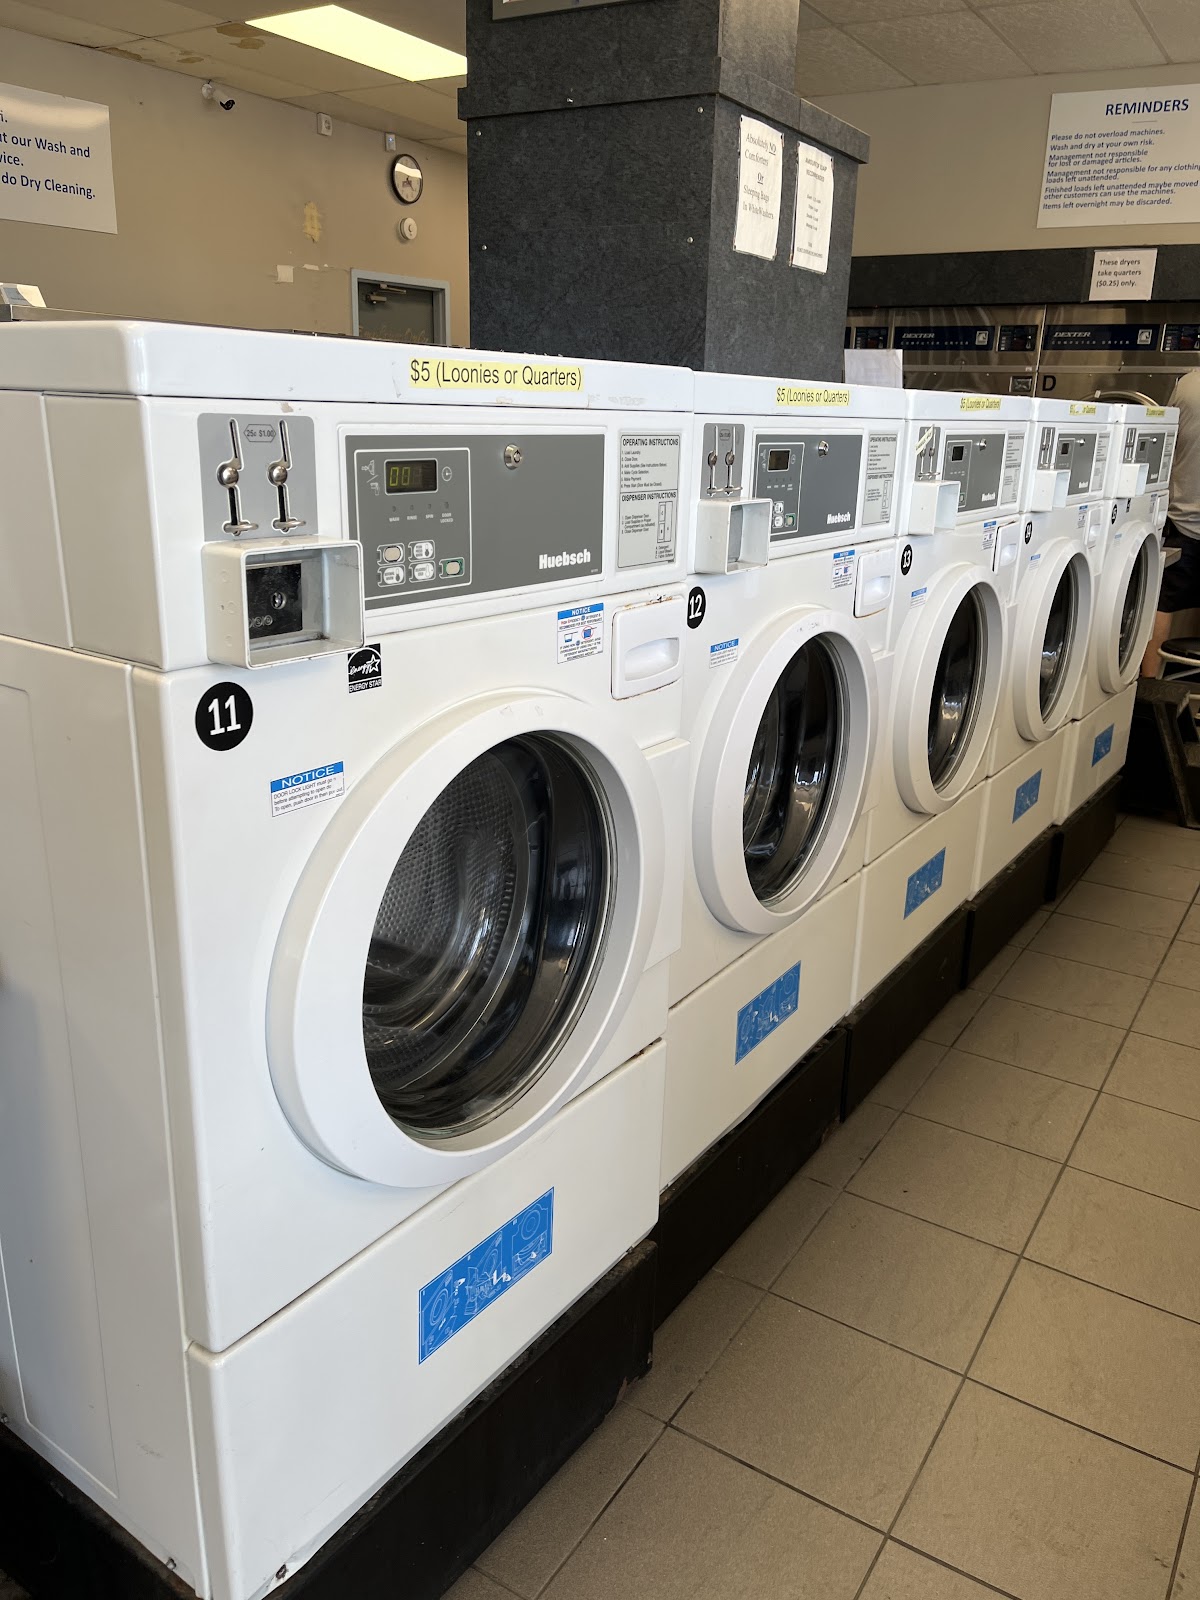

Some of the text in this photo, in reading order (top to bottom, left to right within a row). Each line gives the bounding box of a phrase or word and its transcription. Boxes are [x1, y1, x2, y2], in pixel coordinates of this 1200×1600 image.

[1106, 98, 1189, 116] REMINDERS
[1098, 130, 1128, 138] overload
[12, 135, 32, 147] our
[34, 138, 66, 154] Wash
[70, 146, 90, 158] and
[746, 133, 769, 152] Absolutely
[744, 150, 768, 166] Comforters
[1049, 153, 1093, 162] Management
[1108, 149, 1148, 158] responsible
[757, 172, 764, 182] Or
[1047, 169, 1091, 178] Management
[1106, 166, 1146, 174] responsible
[2, 172, 96, 200] do Dry Cleaning.
[744, 184, 760, 200] Sleeping
[1106, 182, 1146, 190] unattended
[1148, 181, 1172, 189] maybe
[1076, 200, 1108, 208] overnight
[1136, 198, 1172, 206] discarded.
[1120, 258, 1140, 266] dryers
[1096, 280, 1119, 288] ($0.25)
[410, 359, 582, 390] $5 (Loonies or Quarters)
[1042, 375, 1056, 391] D
[776, 387, 850, 406] $5 (Loonies or Quarters)
[826, 511, 851, 524] Huebsch
[539, 549, 591, 570] Huebsch
[903, 550, 911, 568] 13
[572, 607, 590, 616] NOTICE
[689, 594, 702, 619] 12
[714, 640, 735, 651] NOTICE
[349, 679, 382, 692] ENERGY STAR
[208, 694, 241, 736] 11
[282, 766, 334, 788] NOTICE
[274, 791, 288, 799] DOOR
[302, 782, 316, 790] LIGHT
[289, 792, 310, 801] attempting
